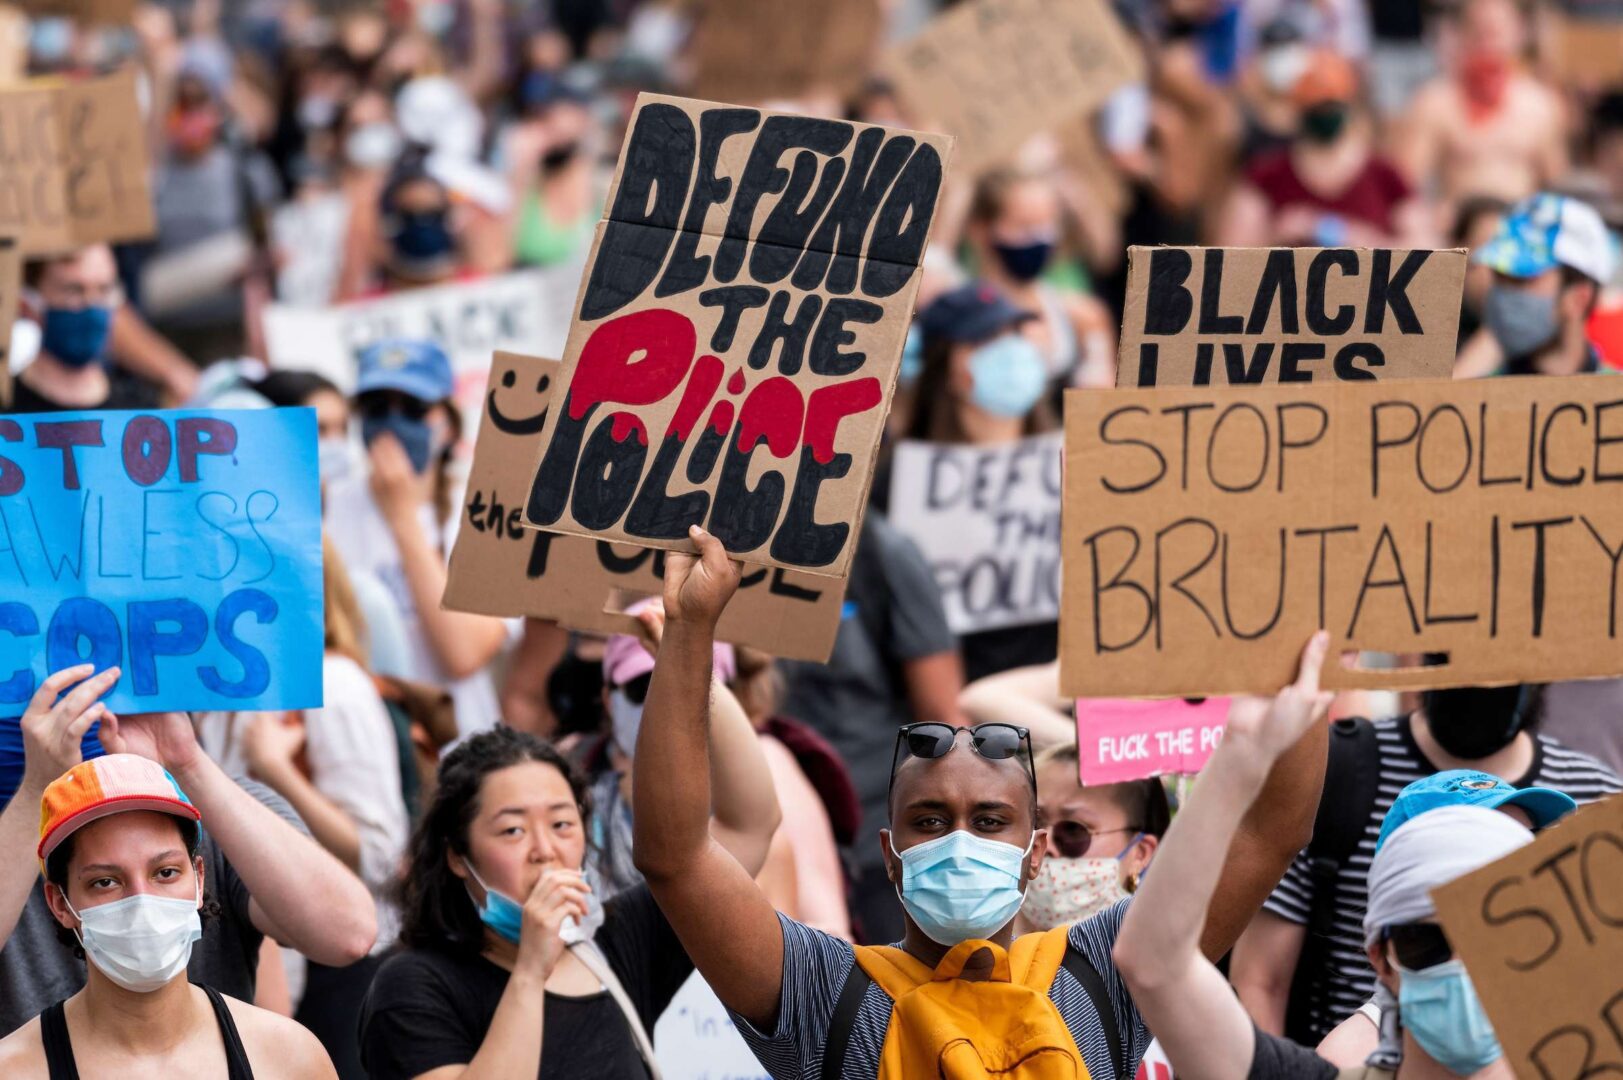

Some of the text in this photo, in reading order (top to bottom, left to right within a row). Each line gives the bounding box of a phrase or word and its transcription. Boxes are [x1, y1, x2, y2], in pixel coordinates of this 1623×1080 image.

[580, 102, 942, 321] DEFUND
[699, 285, 884, 376] THE
[1143, 248, 1433, 335] BLACK
[1100, 400, 1623, 498] STOP POLICE
[467, 489, 525, 541] the
[1083, 514, 1623, 655] BRUTALITY
[1098, 732, 1149, 763] FUCK
[1155, 727, 1194, 756] THE
